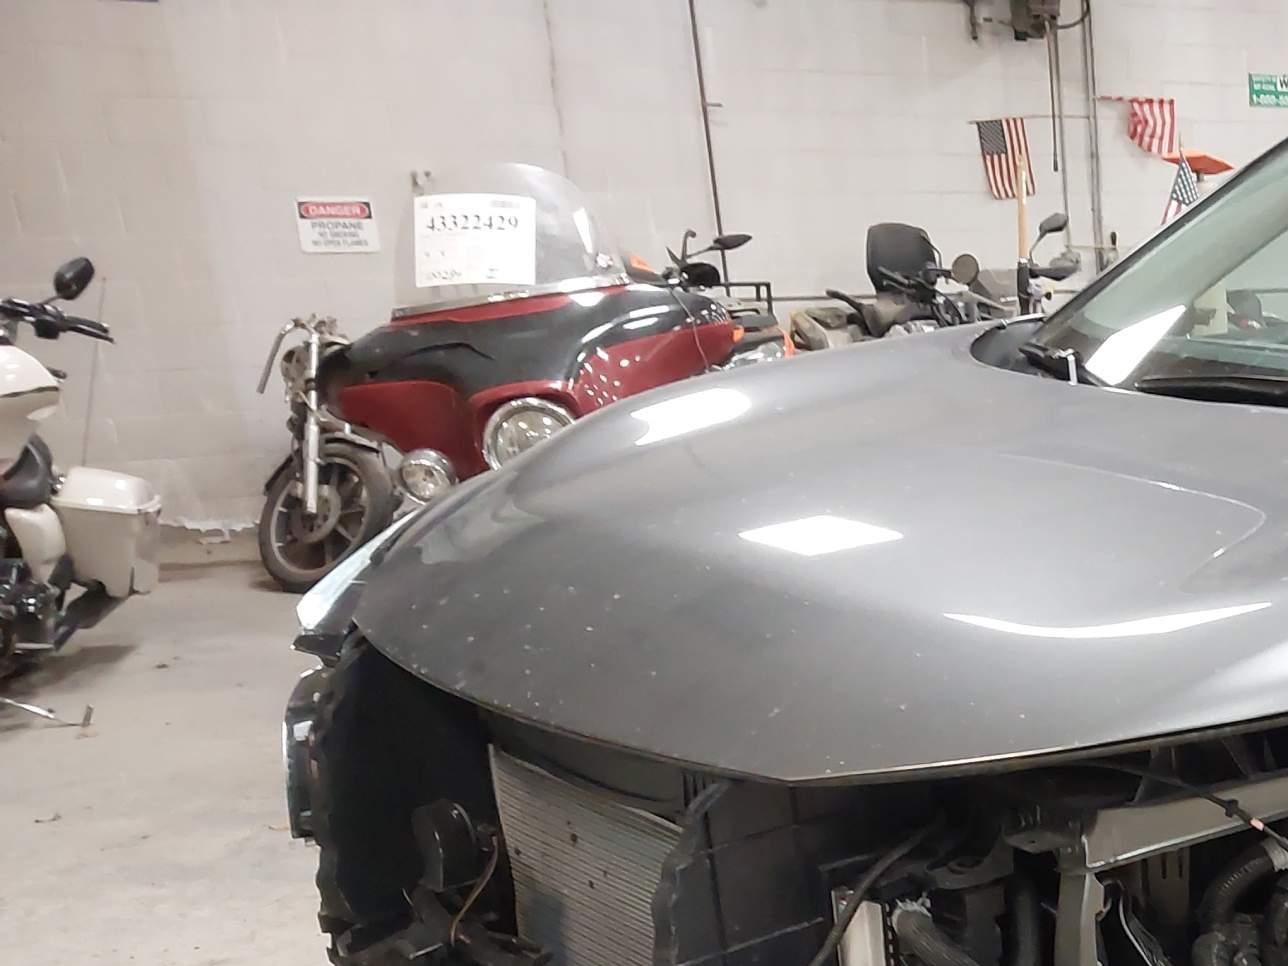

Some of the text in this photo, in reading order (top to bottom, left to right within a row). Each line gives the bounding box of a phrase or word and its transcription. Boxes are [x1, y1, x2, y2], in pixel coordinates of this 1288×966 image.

[307, 205, 361, 217] DANGER
[311, 221, 364, 231] PROPANE
[425, 213, 519, 232] 43322429
